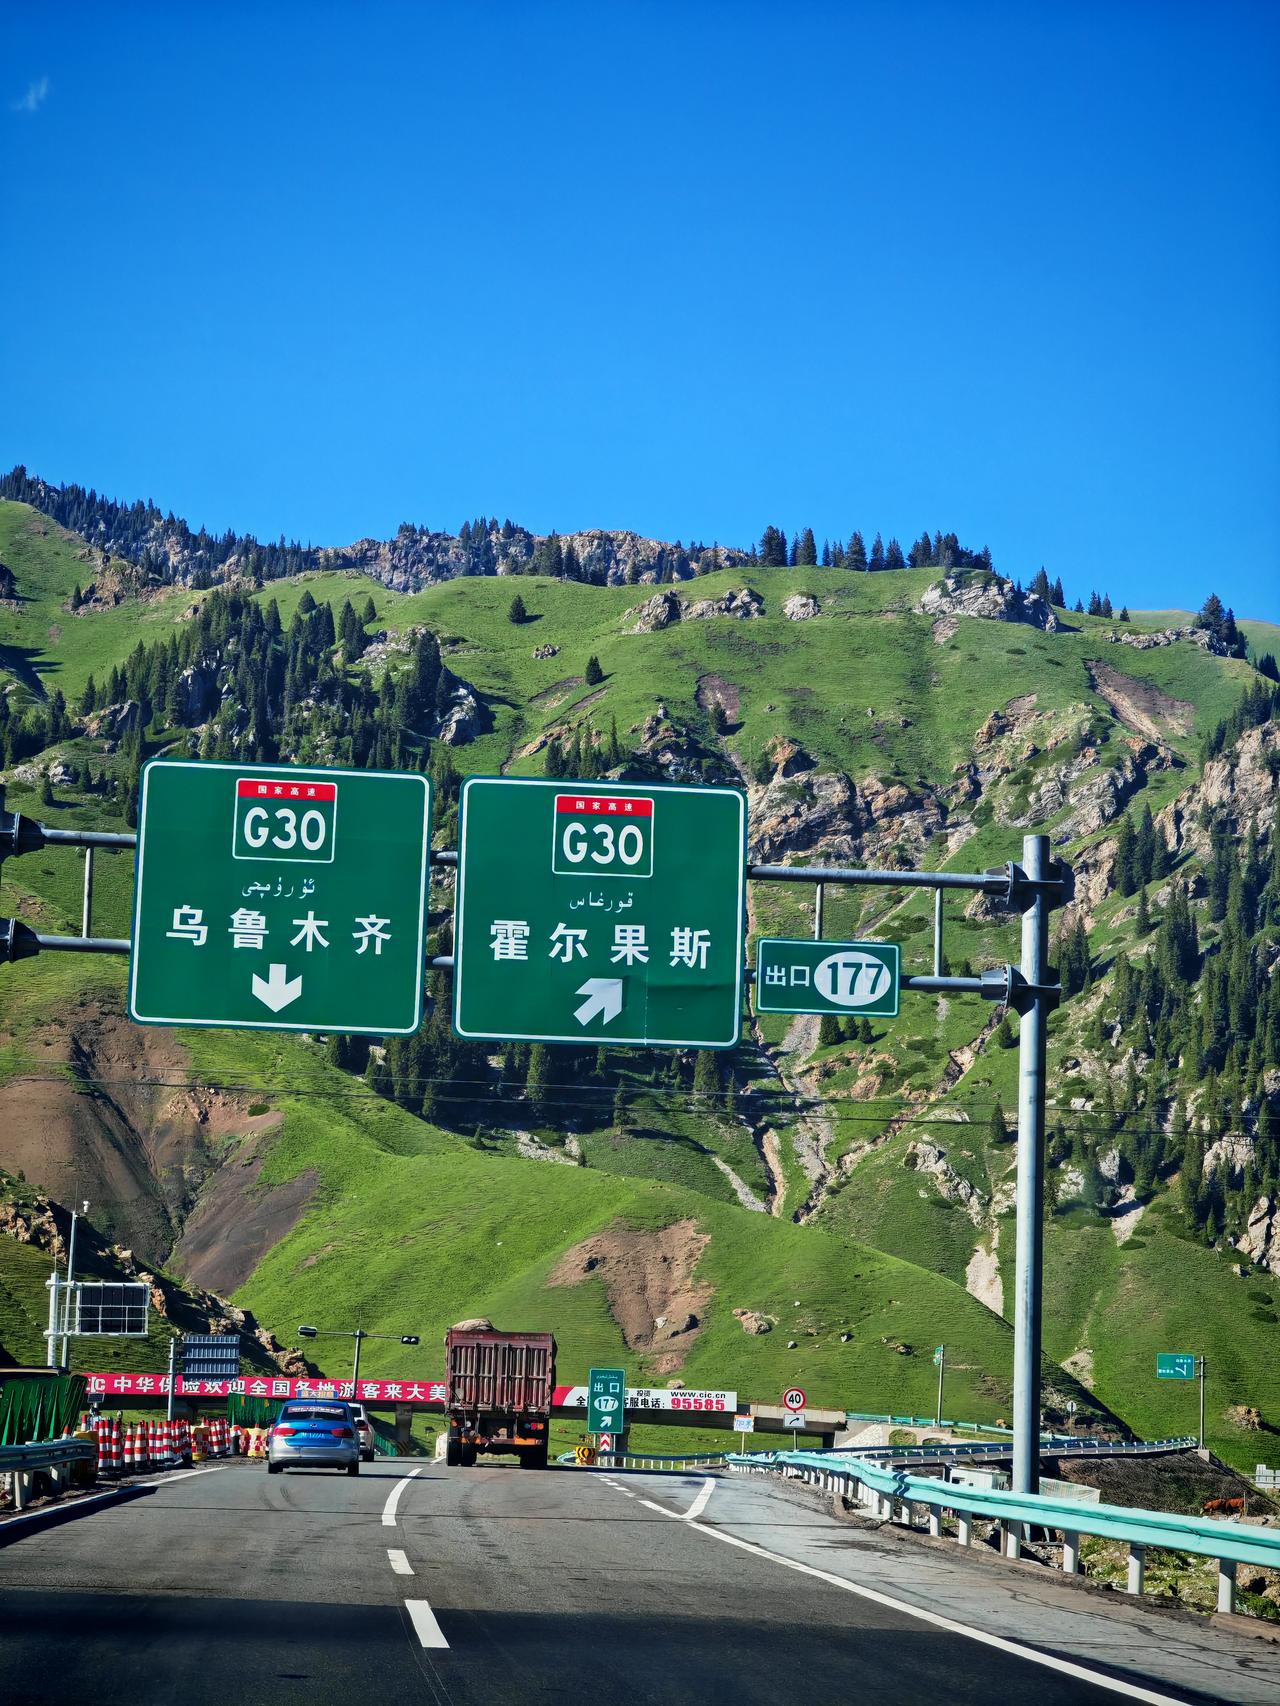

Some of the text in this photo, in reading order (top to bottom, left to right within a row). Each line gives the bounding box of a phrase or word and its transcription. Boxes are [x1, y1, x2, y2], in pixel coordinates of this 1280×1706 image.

[257, 784, 316, 797] 国家高速
[575, 800, 633, 812] 国家高速
[244, 806, 326, 851] G30
[563, 822, 643, 865] G30
[166, 904, 392, 955] 乌鲁木齐
[488, 919, 711, 969] 霍尔果斯
[765, 961, 884, 995] 出口 177
[594, 1382, 620, 1393] 出口
[671, 1391, 726, 1399] www.cic.cn
[788, 1393, 802, 1404] 40
[597, 1398, 617, 1409] 177
[671, 1398, 725, 1411] 95585
